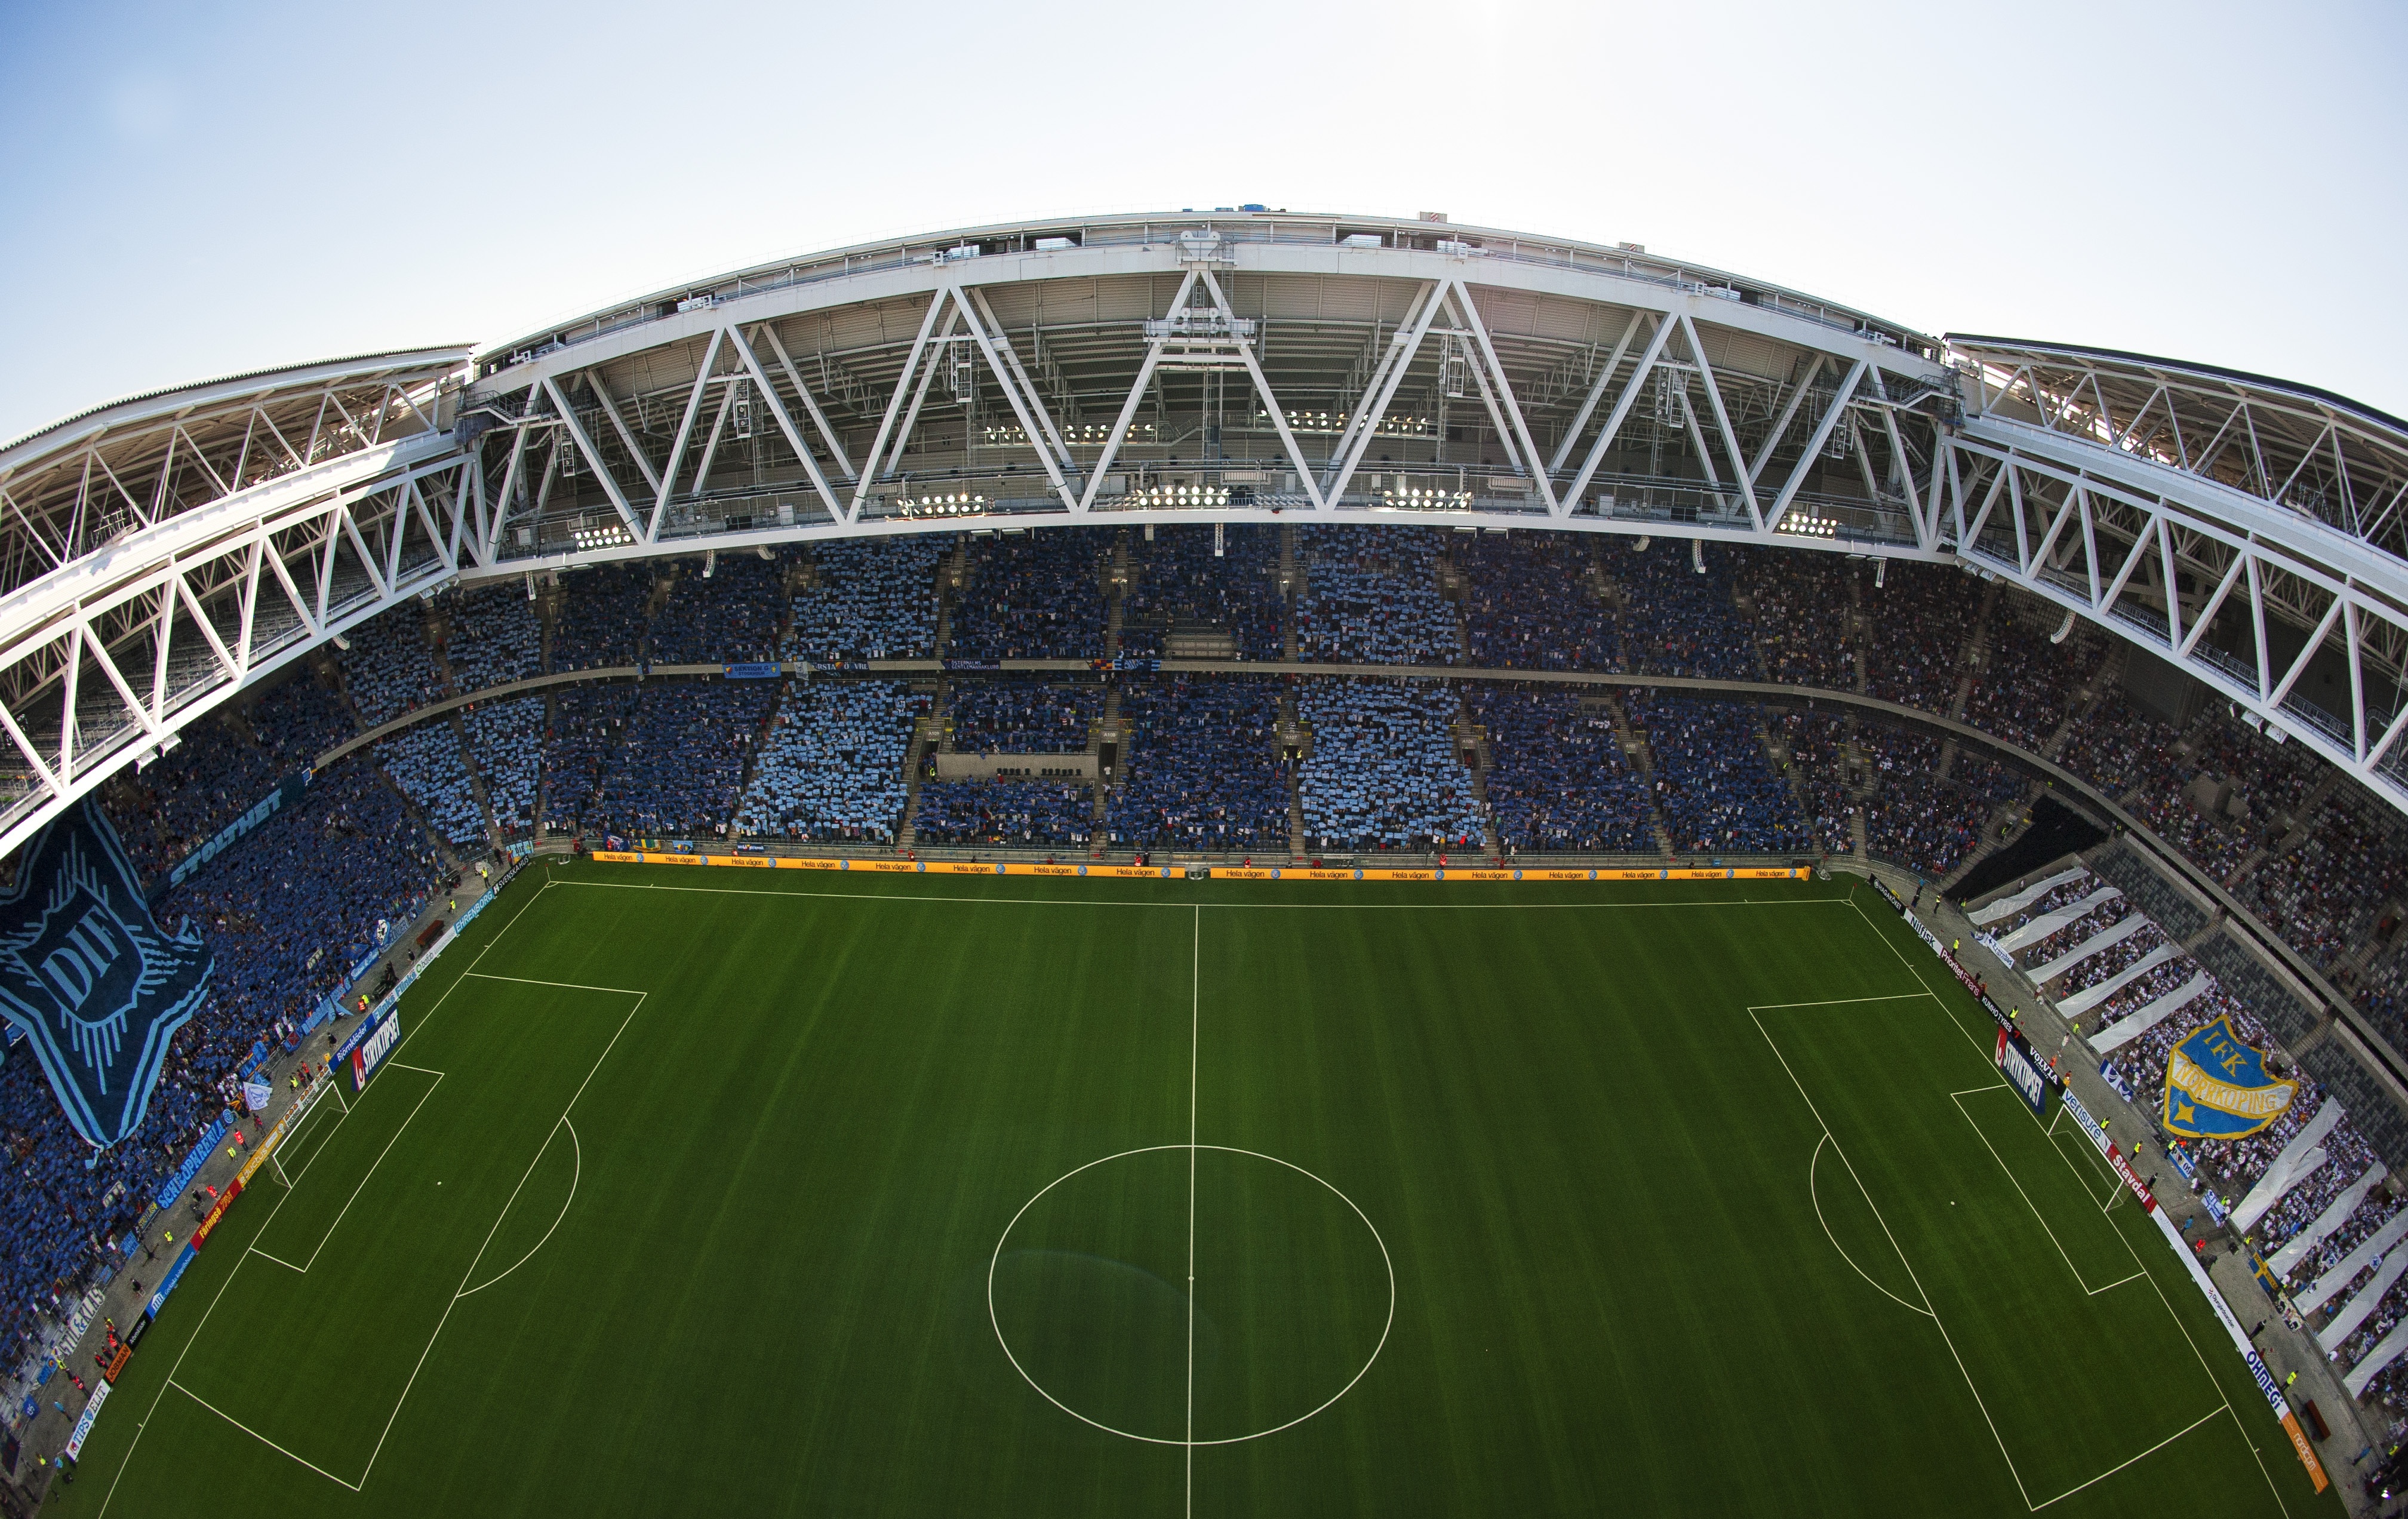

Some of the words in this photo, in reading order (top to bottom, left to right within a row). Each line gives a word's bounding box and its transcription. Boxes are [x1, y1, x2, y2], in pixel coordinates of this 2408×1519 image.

[170, 788, 282, 890] STOLTHET
[455, 891, 493, 933] EHRENBORG
[1878, 883, 1902, 910] HAGAKÖKET
[1911, 916, 1936, 948] Nilfisk
[40, 905, 121, 1011] DIF
[1982, 995, 1999, 1017] KUMHO
[1997, 1013, 2012, 1032] TYRES
[337, 1023, 367, 1062] Björnkläder
[362, 1008, 400, 1075] STRYKTIPSET
[2203, 1030, 2247, 1077] IFK
[2003, 1041, 2043, 1106] STRYKTIPSET
[2030, 1046, 2058, 1085] VOLVIA
[2065, 1090, 2101, 1139] verisure
[239, 1148, 267, 1183] eductus
[2113, 1154, 2150, 1203] Stavdal
[199, 1206, 222, 1238] Färingsö
[109, 1347, 130, 1380] JOBMAN
[73, 1418, 90, 1444] TIPS
[90, 1385, 106, 1414] ELIT
